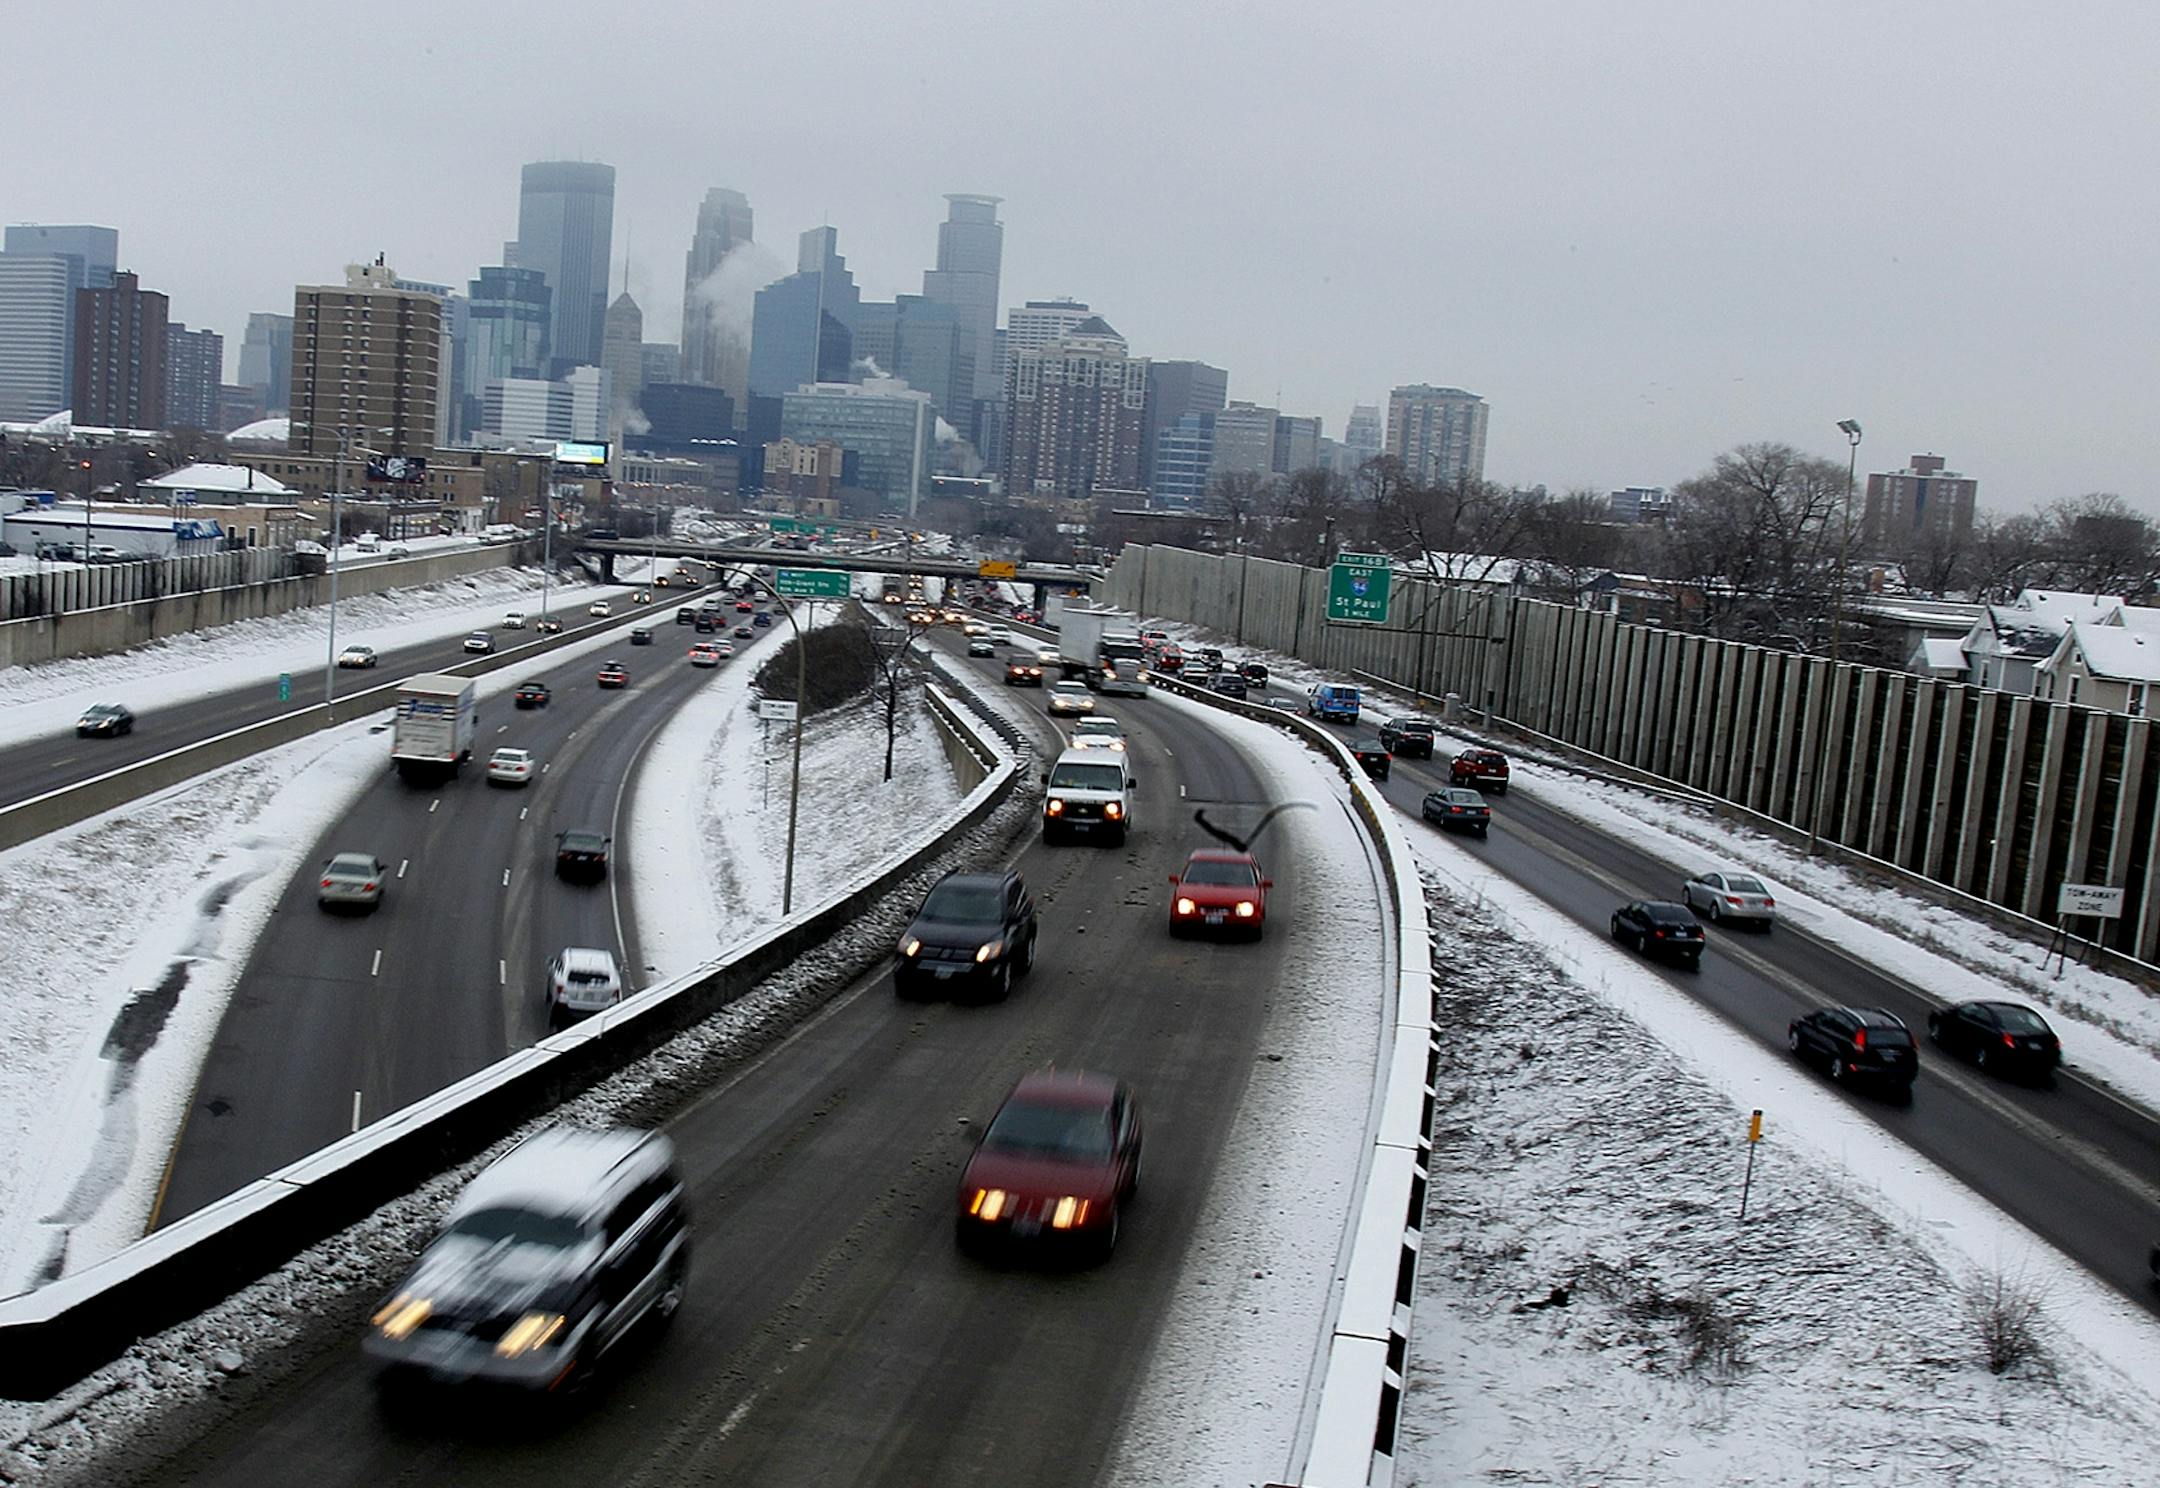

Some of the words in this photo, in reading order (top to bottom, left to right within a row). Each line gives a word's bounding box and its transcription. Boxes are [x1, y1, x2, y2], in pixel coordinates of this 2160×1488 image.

[1349, 568, 1373, 577] EAST
[1336, 597, 1349, 606] St
[1353, 598, 1382, 609] Paul
[1352, 610, 1370, 618] MILE
[2067, 888, 2117, 899] TOW-AWAY
